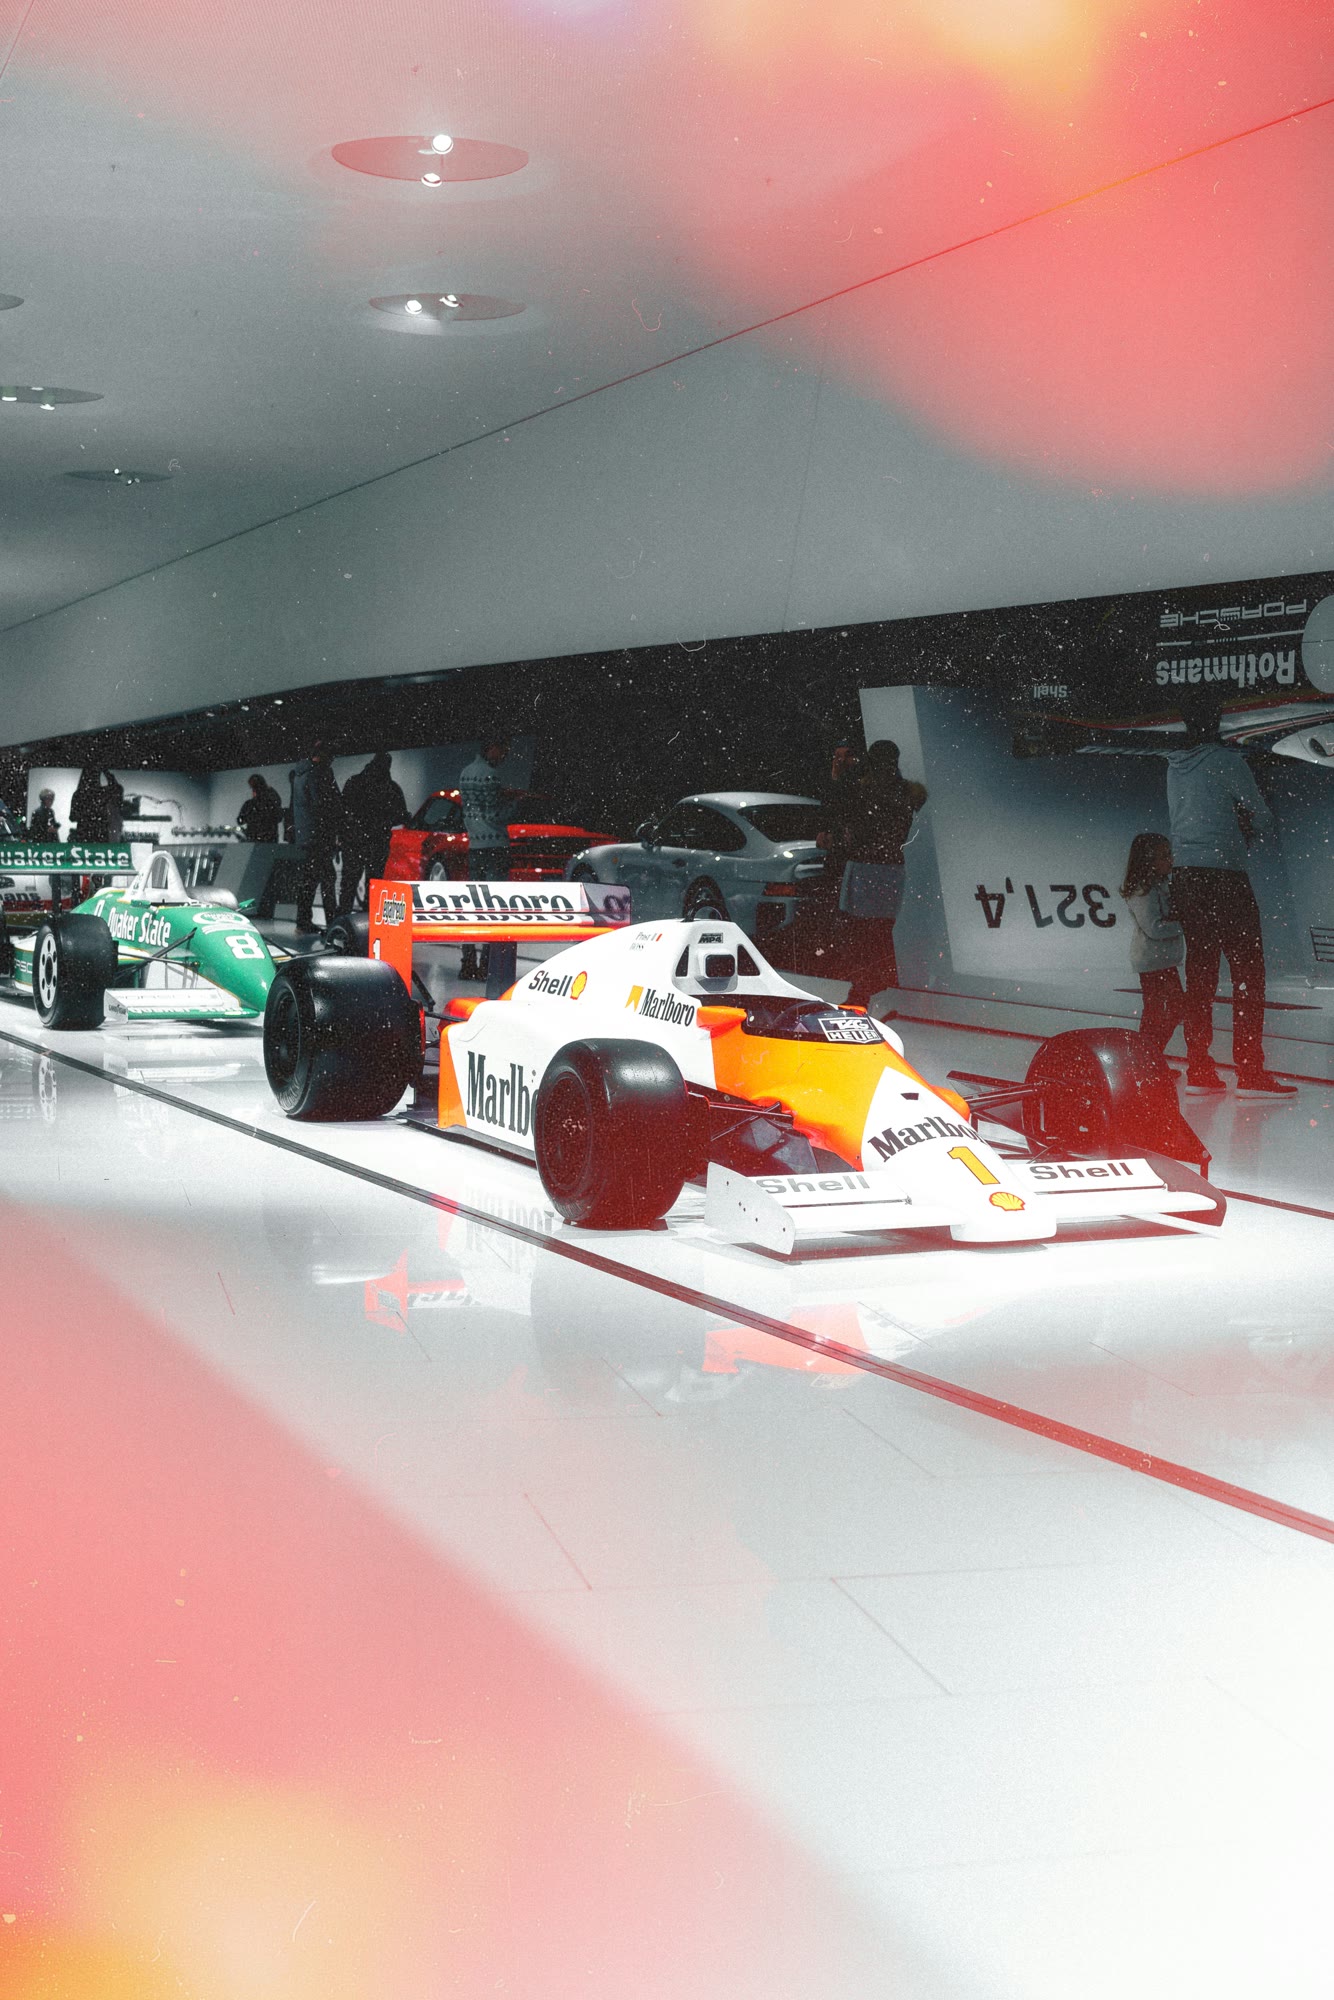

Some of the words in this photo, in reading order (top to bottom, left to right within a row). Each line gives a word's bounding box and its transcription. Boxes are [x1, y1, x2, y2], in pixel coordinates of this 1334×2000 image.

[1160, 600, 1307, 628] PORSCHE
[1156, 651, 1296, 688] Rothmans
[1033, 685, 1068, 699] Shell
[0, 848, 65, 866] uaker
[71, 847, 129, 867] State
[974, 877, 1117, 928] 321,4
[107, 906, 139, 941] Quaker
[138, 912, 172, 948] State
[224, 934, 266, 959] 8
[528, 970, 573, 997] Shell
[639, 988, 695, 1027] Marlboro
[828, 1031, 879, 1041] HEUER
[830, 1019, 870, 1030] TAG
[947, 1146, 1001, 1185] 1
[1029, 1162, 1134, 1181] Shell
[756, 1174, 871, 1195] Shell
